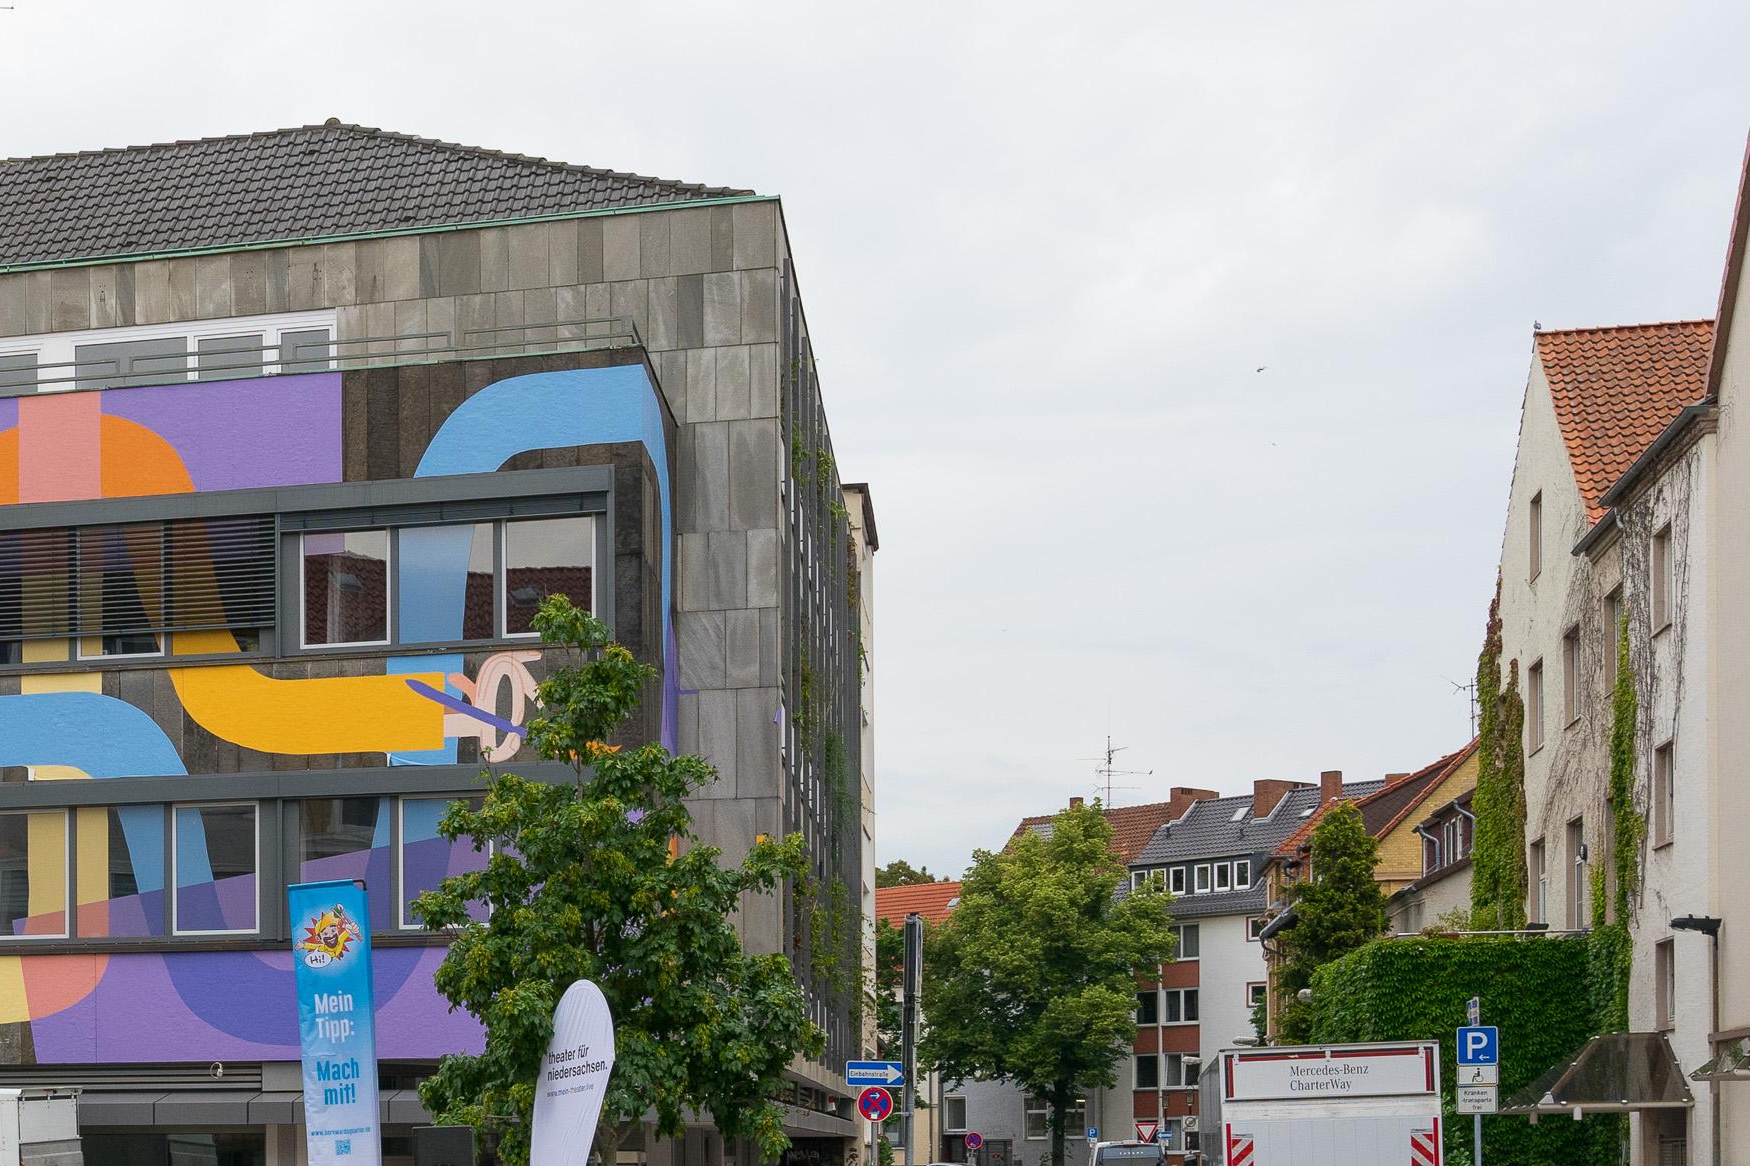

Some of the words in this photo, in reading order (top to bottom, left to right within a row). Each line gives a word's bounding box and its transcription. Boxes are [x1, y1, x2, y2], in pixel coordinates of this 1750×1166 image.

[310, 954, 326, 965] Hi!
[314, 991, 353, 1014] Mein
[315, 1018, 355, 1044] Tipp:
[548, 1049, 576, 1065] theater
[577, 1044, 589, 1060] für
[1467, 1032, 1488, 1060] P
[316, 1057, 360, 1082] Mach
[547, 1060, 608, 1082] niedersachsen.
[850, 1070, 889, 1078] Einbahnstraße
[1289, 1063, 1370, 1078] Mercedes-Benz
[324, 1083, 357, 1105] mit!
[1289, 1078, 1352, 1092] CharterWay
